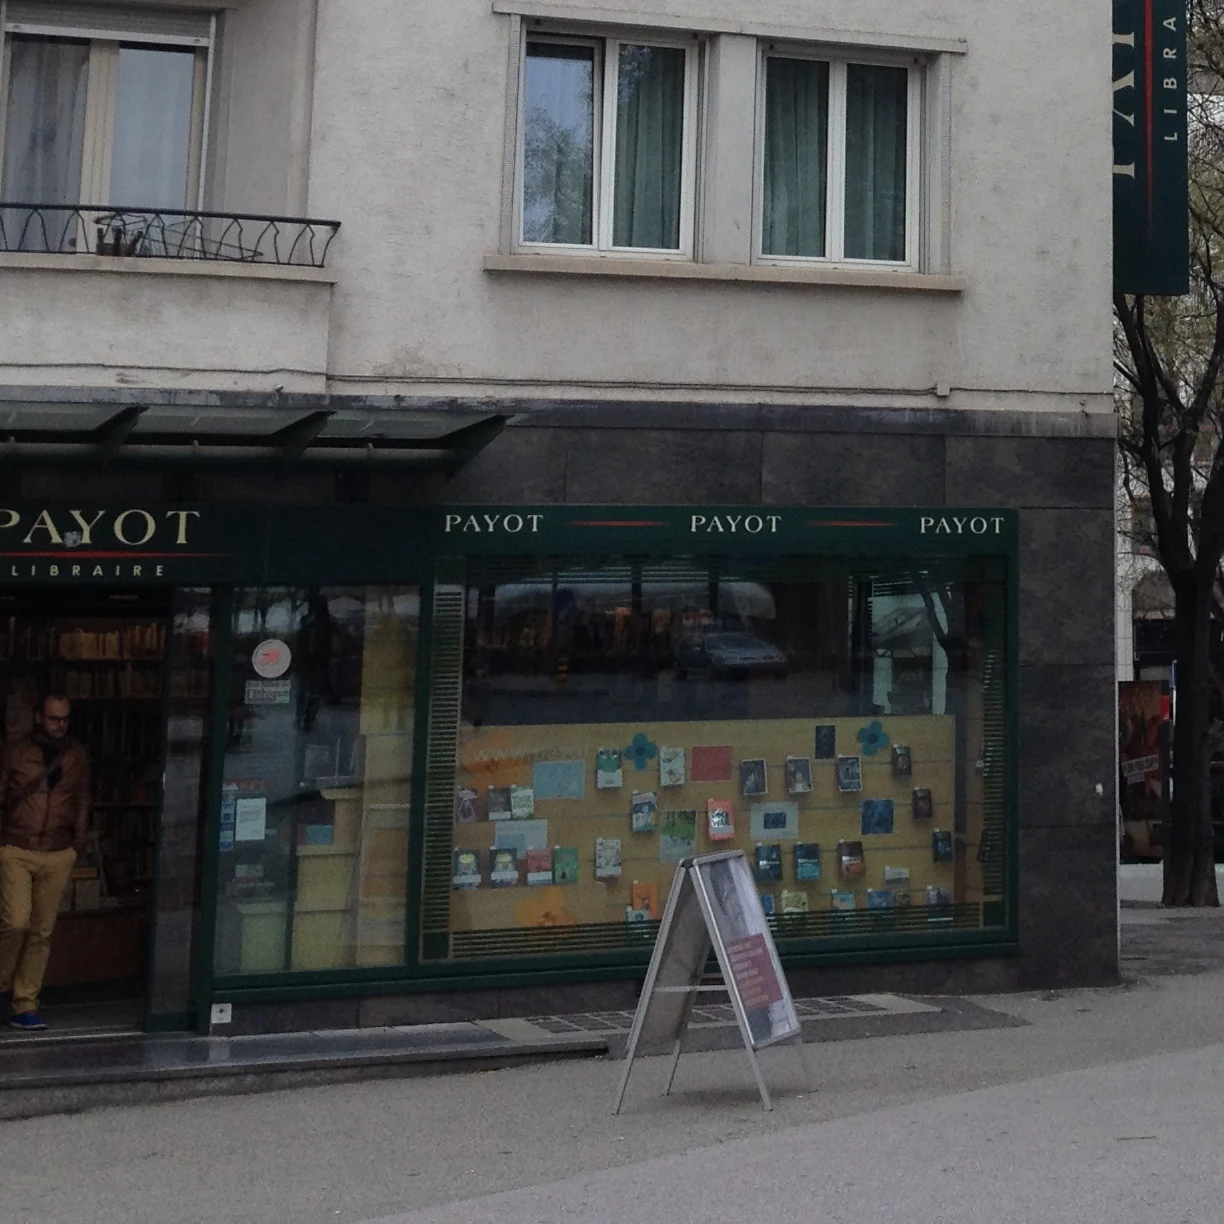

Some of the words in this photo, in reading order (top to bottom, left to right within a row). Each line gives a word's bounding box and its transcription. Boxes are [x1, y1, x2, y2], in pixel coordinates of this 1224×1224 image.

[444, 513, 544, 533] PAYOT
[689, 514, 782, 533] PAYOT
[919, 516, 1005, 534] PAYOT
[10, 564, 165, 577] LIBRAIRE
